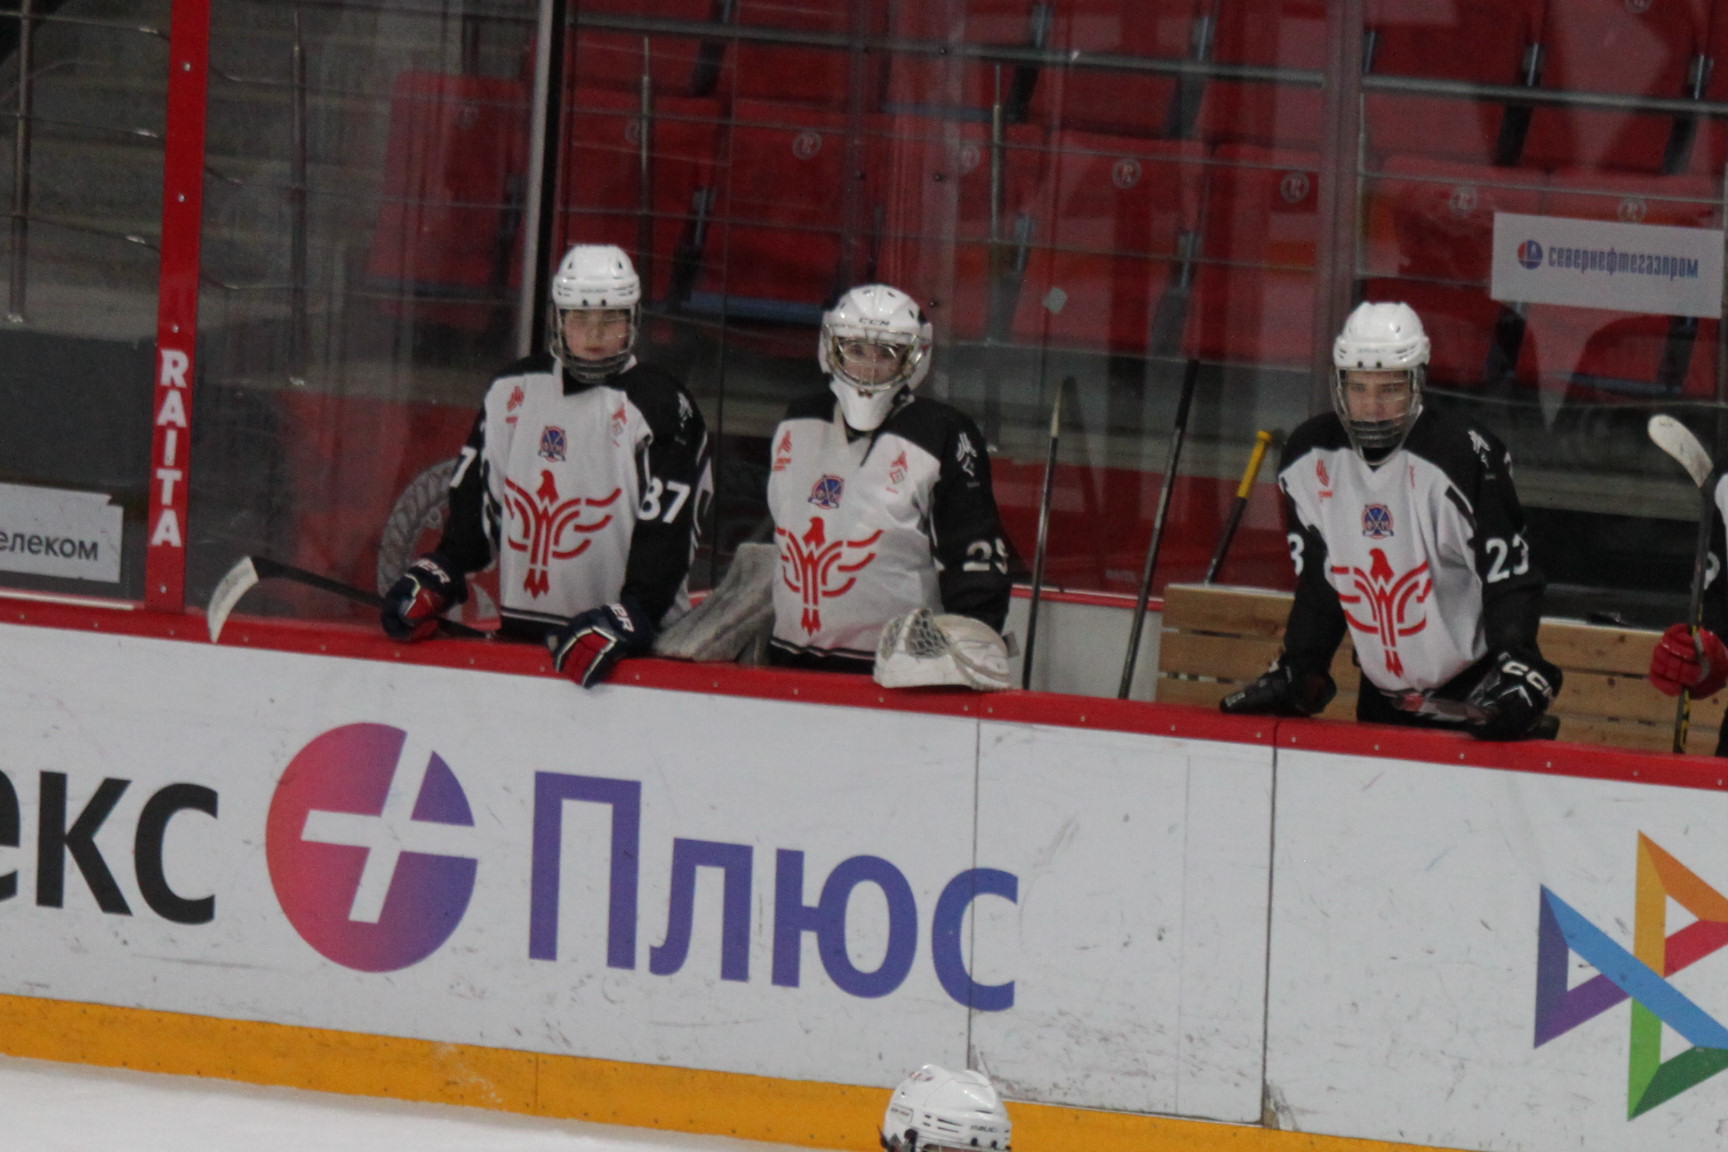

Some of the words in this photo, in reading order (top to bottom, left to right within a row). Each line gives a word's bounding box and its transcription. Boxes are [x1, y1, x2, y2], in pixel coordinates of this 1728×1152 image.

[151, 348, 189, 548] RAITA
[636, 476, 692, 524] 87
[1485, 532, 1530, 584] 23
[0, 768, 219, 925] кс
[528, 770, 1020, 1013] Плюс
